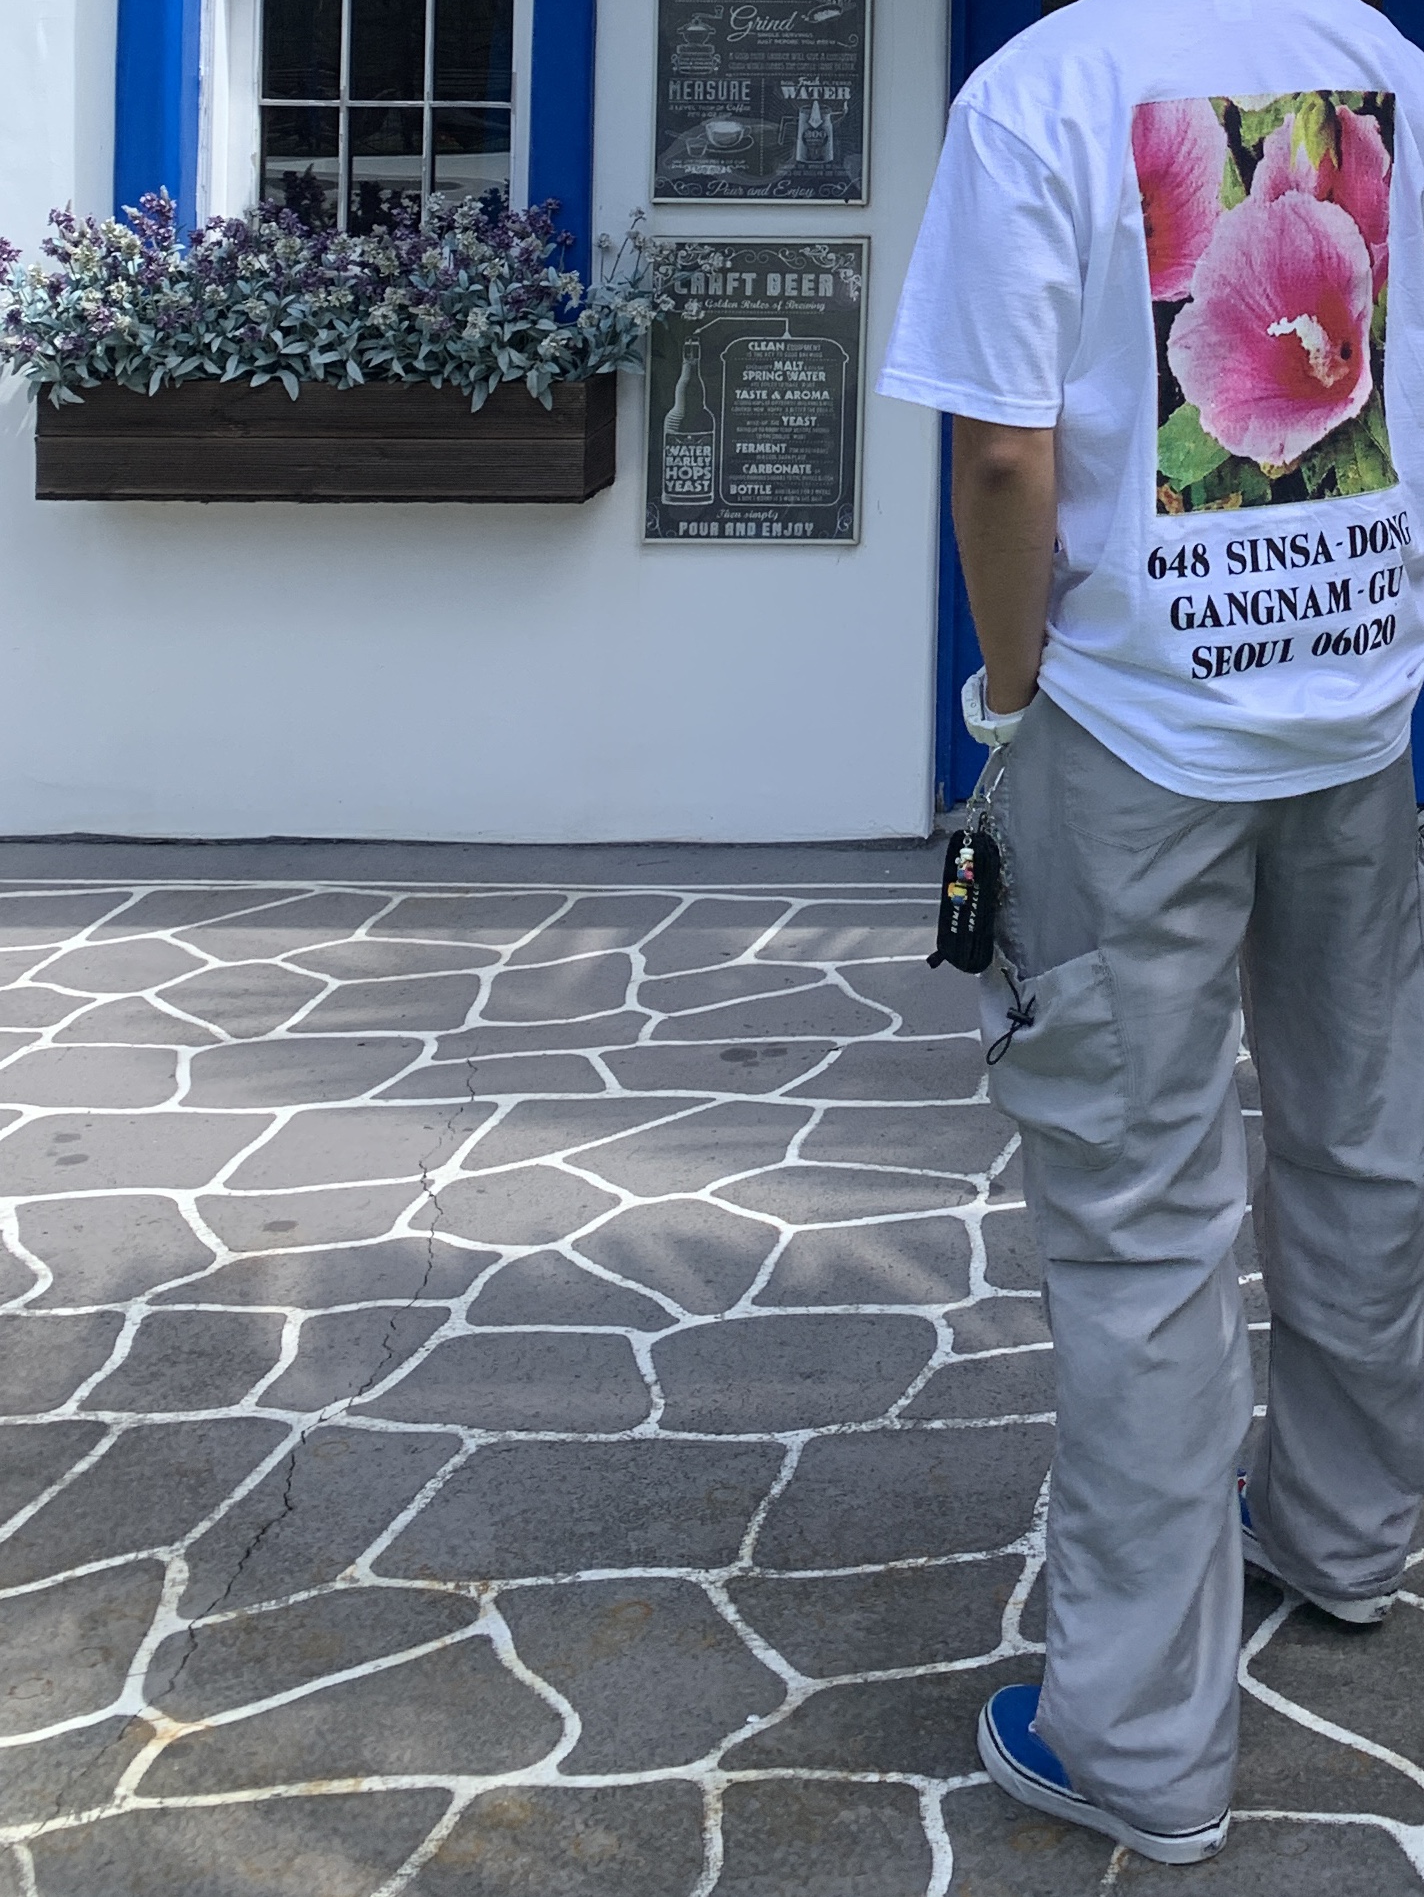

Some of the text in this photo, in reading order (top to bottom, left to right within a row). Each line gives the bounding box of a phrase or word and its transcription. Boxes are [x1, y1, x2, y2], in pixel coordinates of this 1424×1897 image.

[727, 5, 798, 42] Grind
[668, 80, 751, 101] MEASURE
[781, 86, 851, 100] WATER
[706, 180, 815, 198] Pour and Enjoy
[674, 272, 833, 297] CRAFT BEER
[705, 299, 738, 309] Golden
[740, 300, 769, 309] Rules
[772, 300, 782, 311] of
[786, 300, 825, 312] Brewing
[748, 342, 785, 351] CLEAN
[773, 361, 804, 371] MALT
[742, 371, 826, 381] SPRING WATER
[735, 390, 768, 399] TASTE
[771, 390, 780, 399] &
[665, 445, 711, 456] WATER
[736, 443, 787, 453] FERMENT
[666, 457, 711, 466] BARLEY
[666, 467, 711, 480] HOPS
[742, 464, 812, 474] CARBONATE
[666, 480, 710, 492] YEAST
[730, 484, 772, 494] BOTTLE
[743, 509, 778, 520] simply
[679, 522, 814, 537] POUR AND ENJOY
[1147, 510, 1412, 580] 648 SINSA-DONG
[1170, 565, 1404, 631] GANGNAM-GU
[1192, 614, 1396, 680] SEOUL 06020
